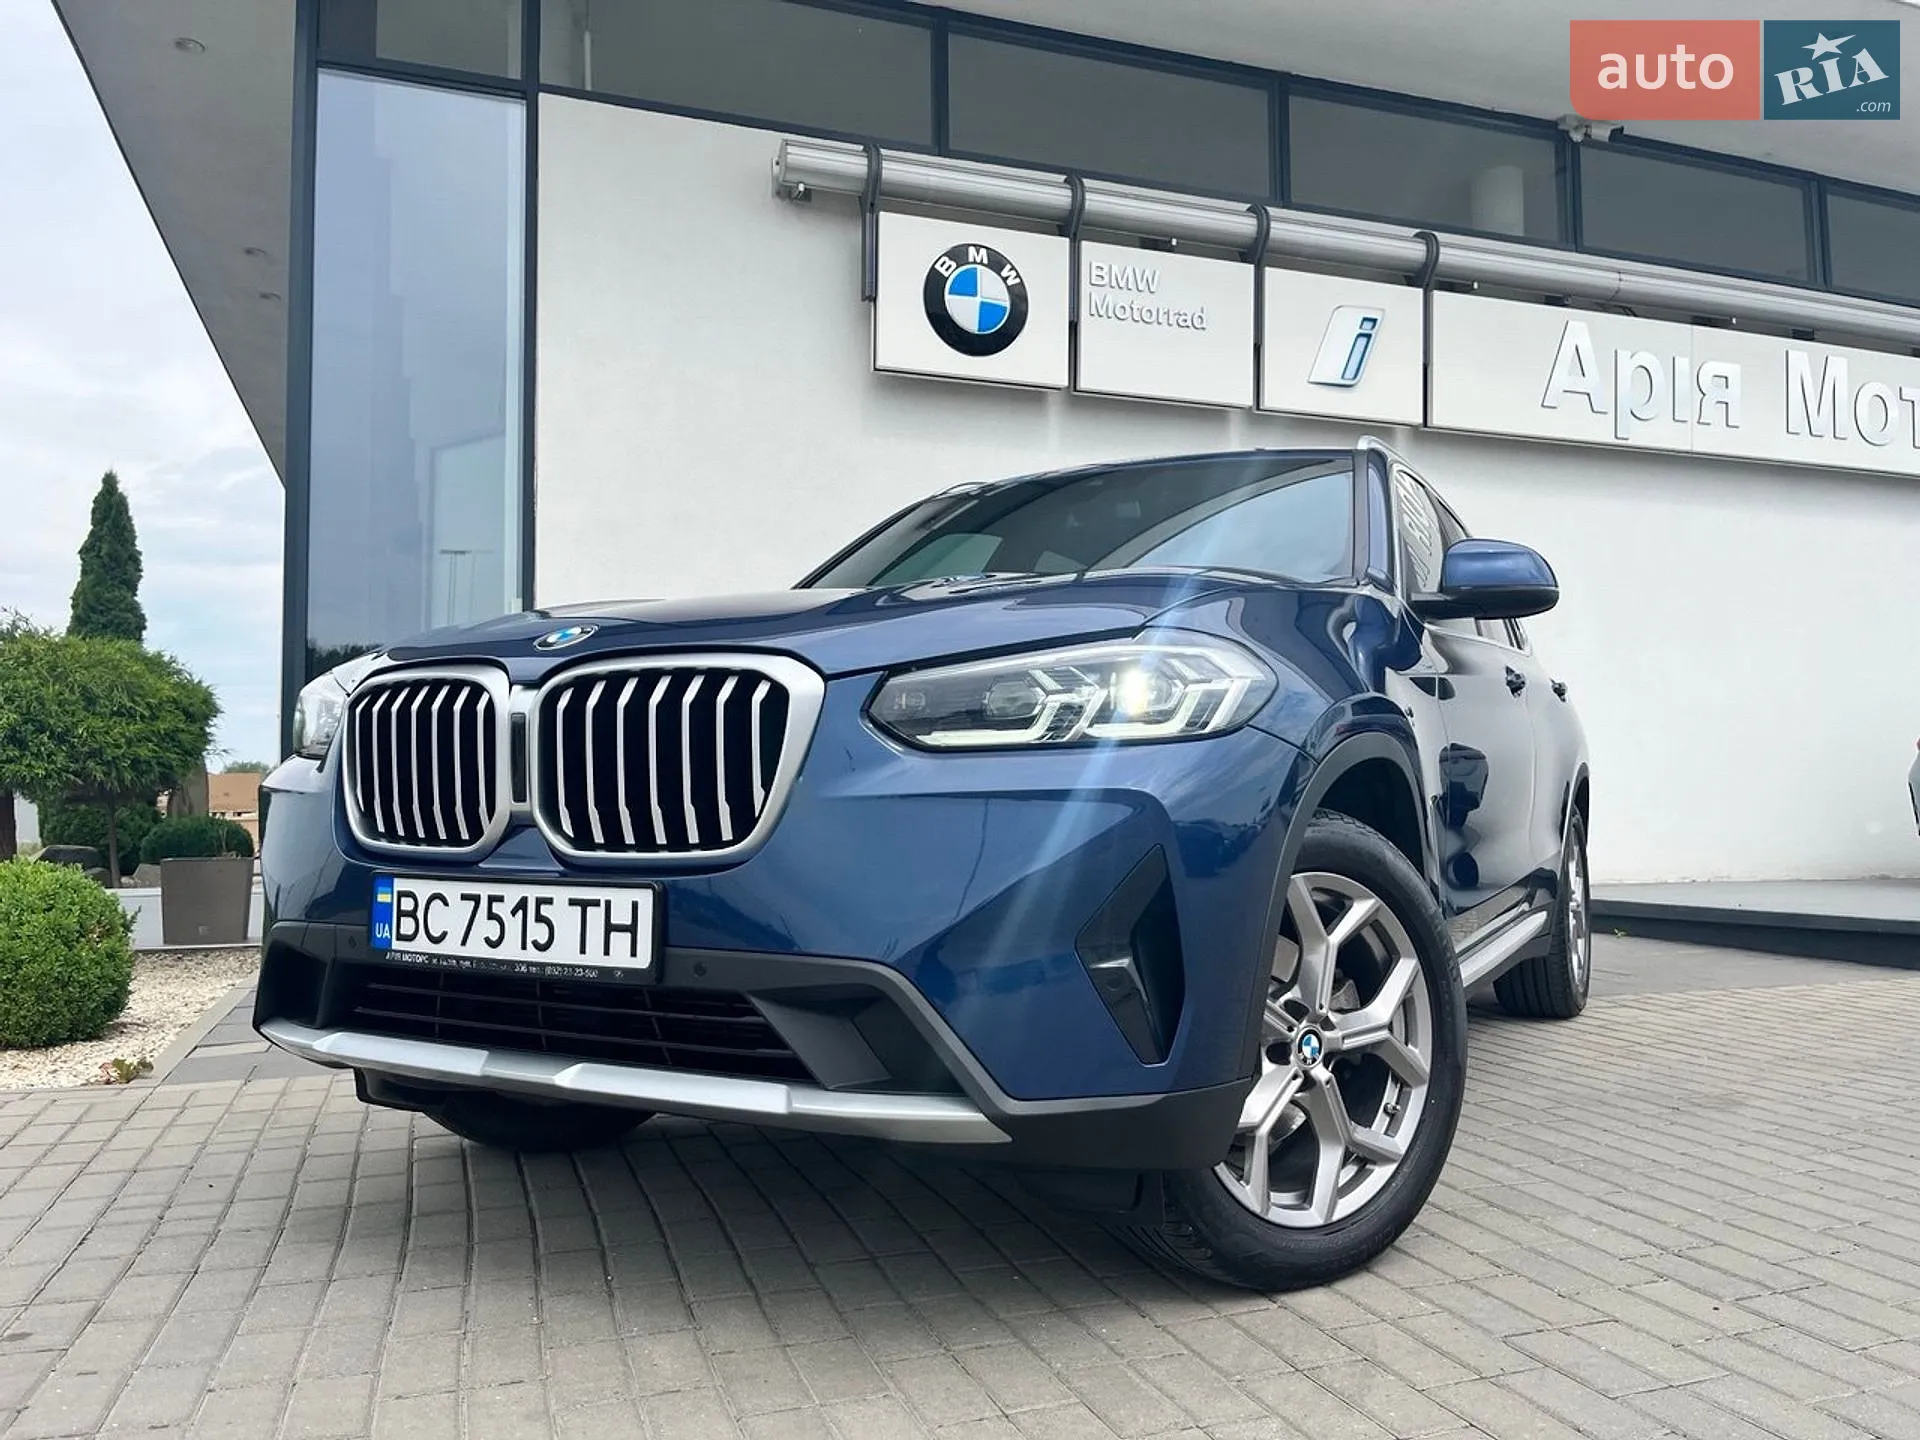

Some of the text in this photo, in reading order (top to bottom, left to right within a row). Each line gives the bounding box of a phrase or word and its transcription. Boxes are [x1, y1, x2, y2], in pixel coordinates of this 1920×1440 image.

[935, 246, 1021, 287] BMW
[1089, 261, 1160, 294] BMW
[1089, 292, 1207, 331] Motorrad
[375, 922, 391, 939] UA
[396, 889, 639, 957] BC 7515 TH
